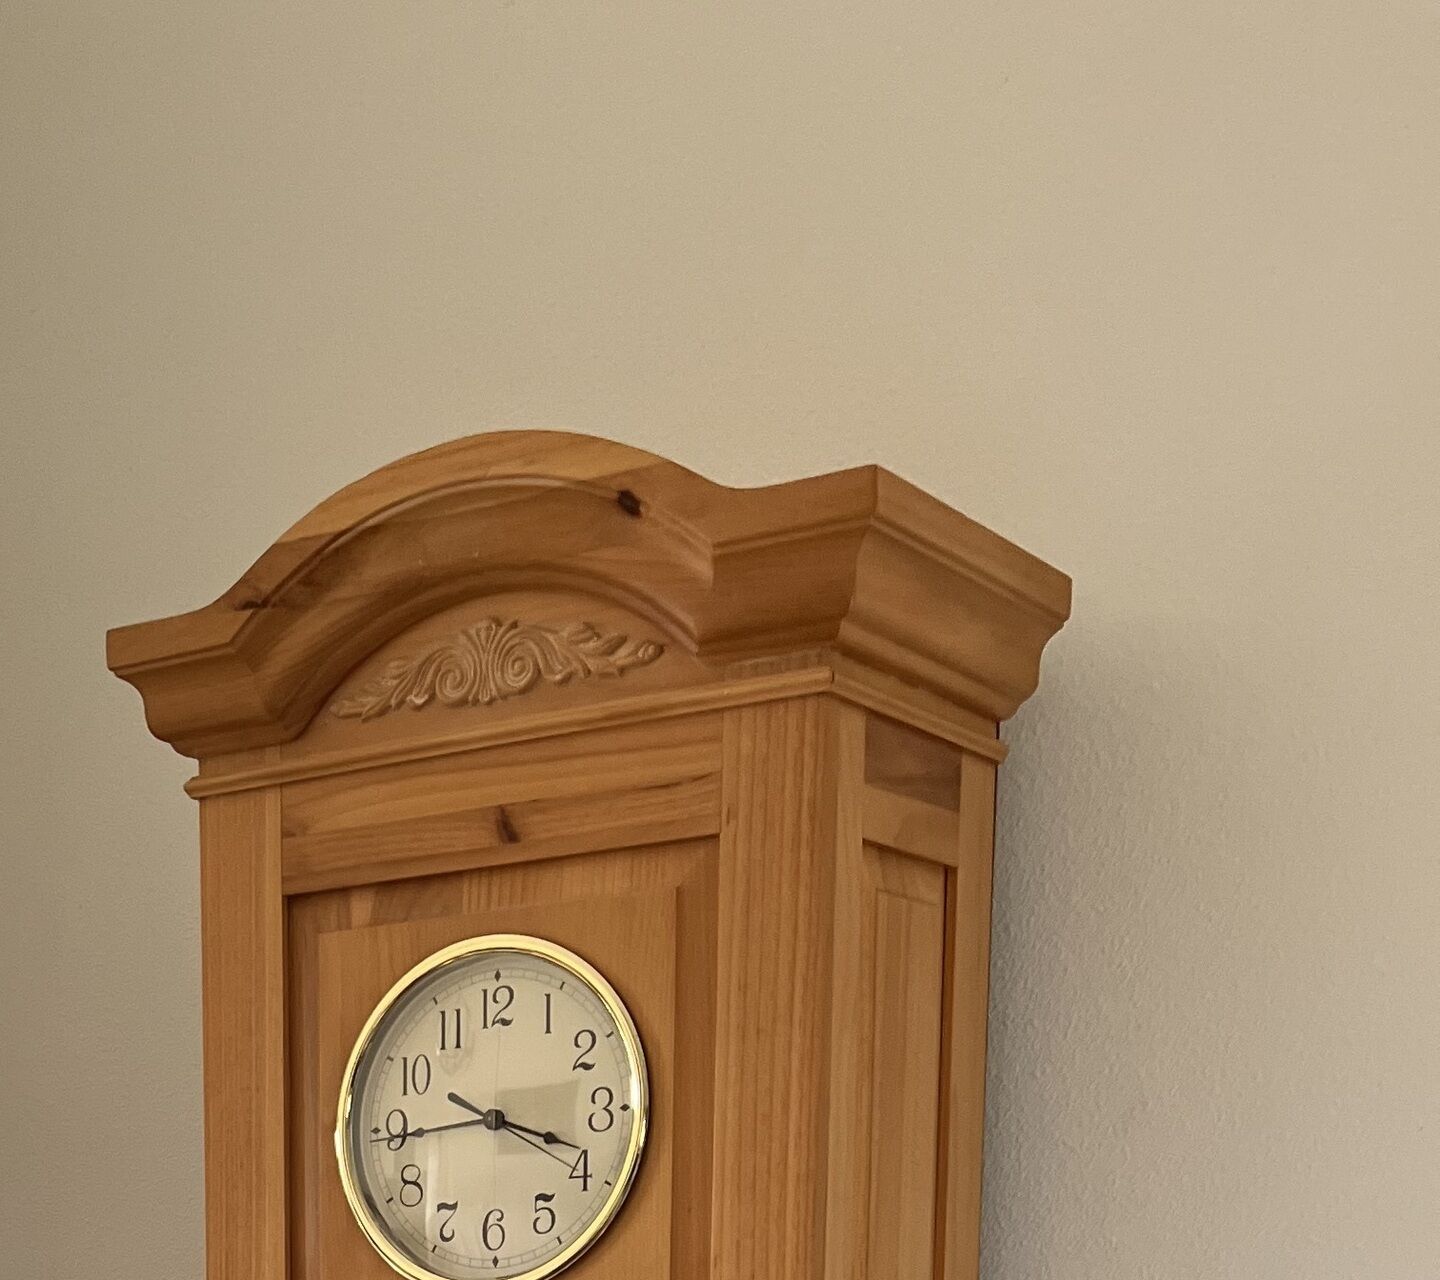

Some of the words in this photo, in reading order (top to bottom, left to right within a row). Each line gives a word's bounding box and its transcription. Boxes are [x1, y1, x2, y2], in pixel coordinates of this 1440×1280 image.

[481, 984, 515, 1030] 12
[544, 993, 552, 1035] 1
[439, 1008, 462, 1051] 11
[572, 1029, 597, 1072] 2
[401, 1053, 432, 1097] 10
[385, 1109, 409, 1151] 9
[587, 1086, 614, 1133] 3
[399, 1164, 424, 1207] 8
[568, 1148, 593, 1192] 4
[436, 1200, 459, 1243] 7
[482, 1208, 506, 1251] 6
[532, 1192, 556, 1235] 5
